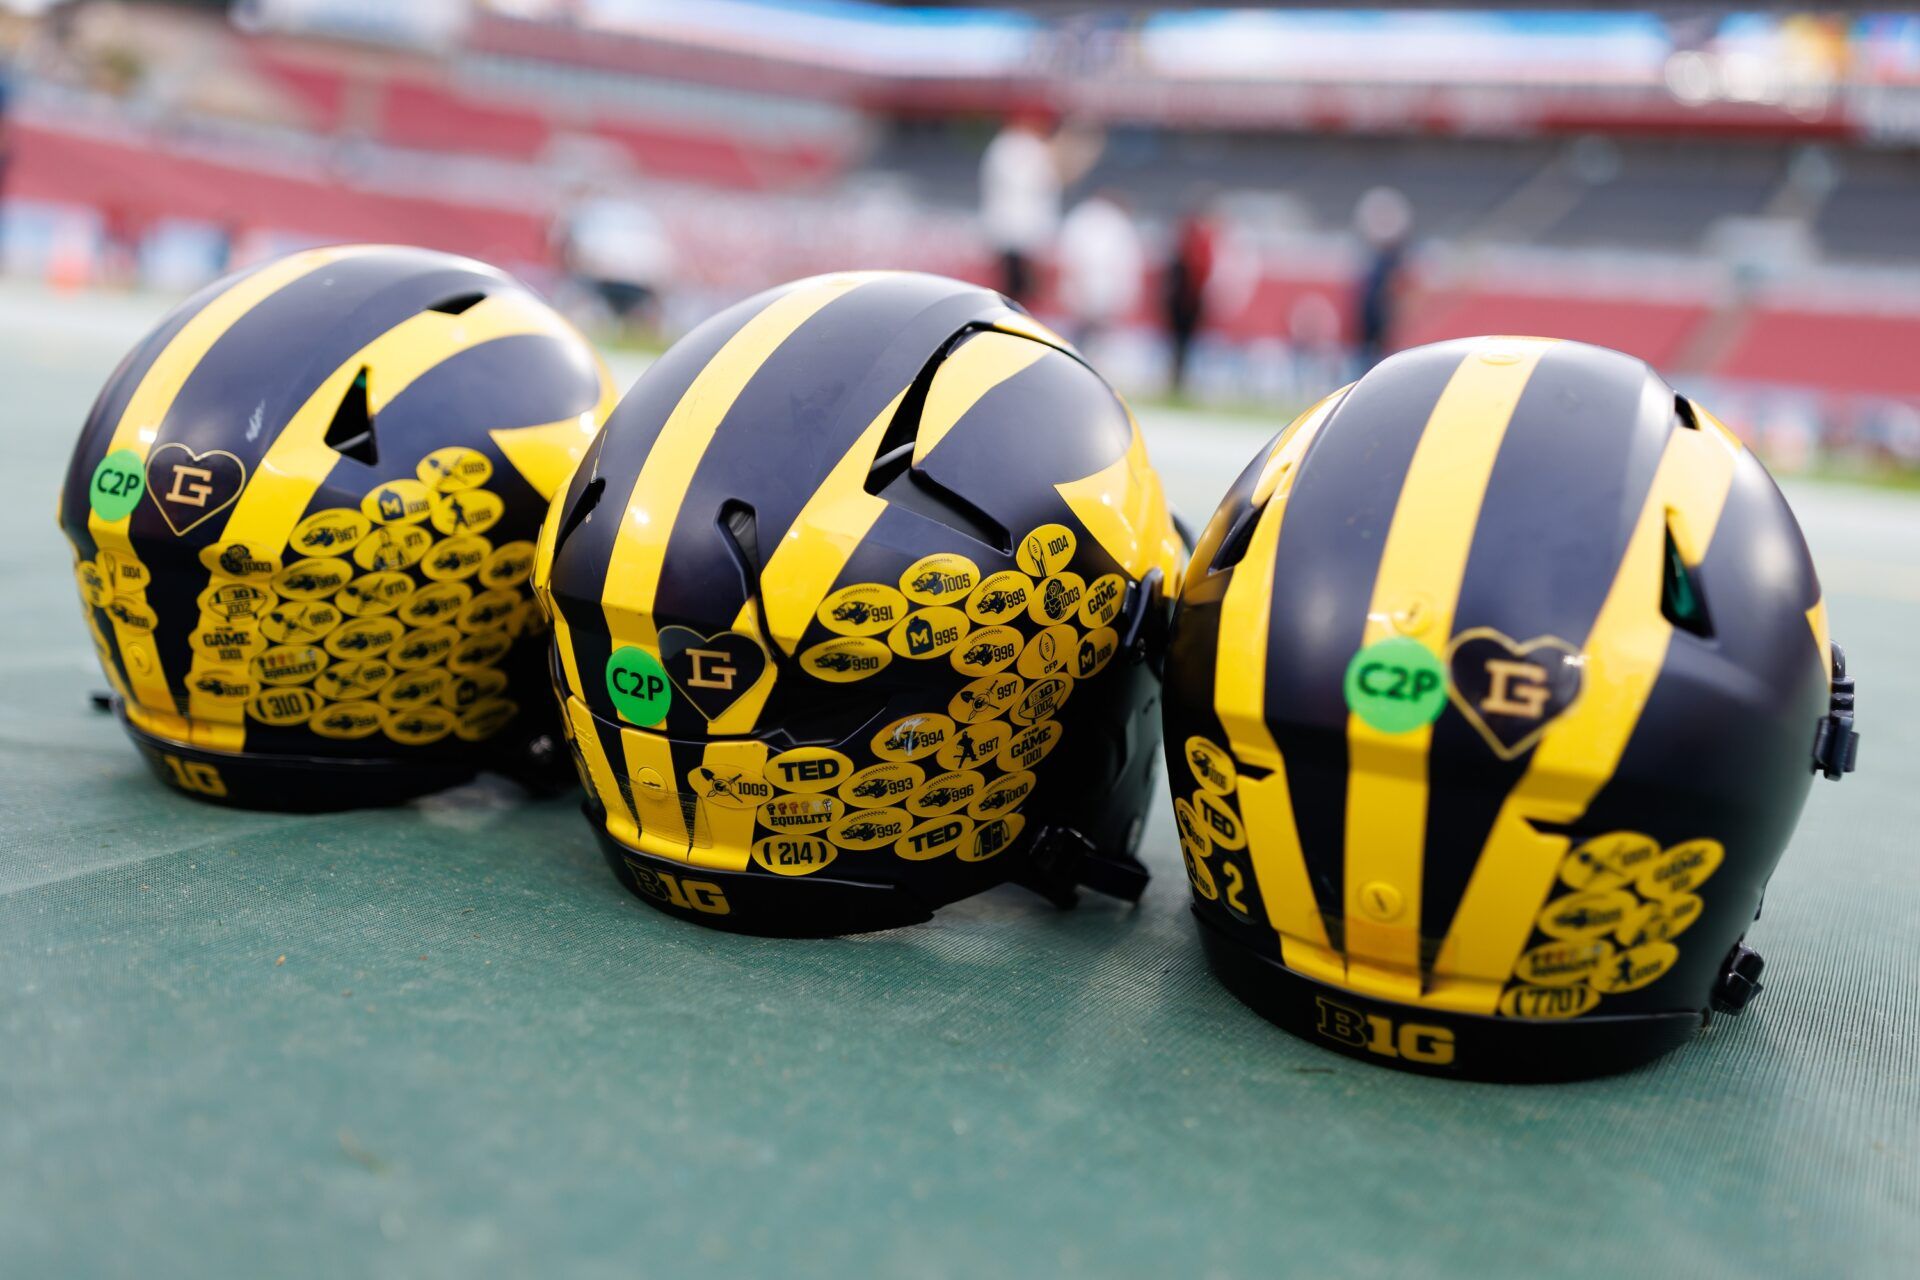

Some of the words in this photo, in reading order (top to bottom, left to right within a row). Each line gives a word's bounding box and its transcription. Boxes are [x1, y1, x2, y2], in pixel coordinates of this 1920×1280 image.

[97, 469, 140, 498] C2P
[1048, 535, 1069, 557] 1004
[943, 577, 972, 595] 1005
[1006, 590, 1028, 608] 999
[1059, 586, 1081, 609] 1003
[1088, 581, 1118, 615] GAME
[870, 605, 895, 623] 991
[202, 632, 252, 647] GAME
[934, 626, 960, 646] 995
[994, 643, 1015, 661] 998
[852, 656, 880, 672] 990
[1044, 660, 1058, 674] CFP
[612, 667, 664, 701] C2P
[997, 680, 1018, 700] 997
[1358, 662, 1441, 702] C2P
[1034, 697, 1055, 717] 1002
[920, 733, 946, 748] 994
[978, 737, 1000, 756] 997
[1011, 726, 1052, 758] GAME
[1022, 747, 1043, 768] 1001
[778, 758, 841, 783] TED
[738, 783, 769, 797] 1009
[888, 778, 915, 795] 993
[951, 784, 974, 802] 996
[1005, 782, 1029, 805] 1000
[770, 812, 833, 828] EQUALITY
[1201, 797, 1237, 841] TED
[877, 822, 902, 839] 992
[908, 821, 964, 853] TED
[1223, 861, 1249, 915] 2
